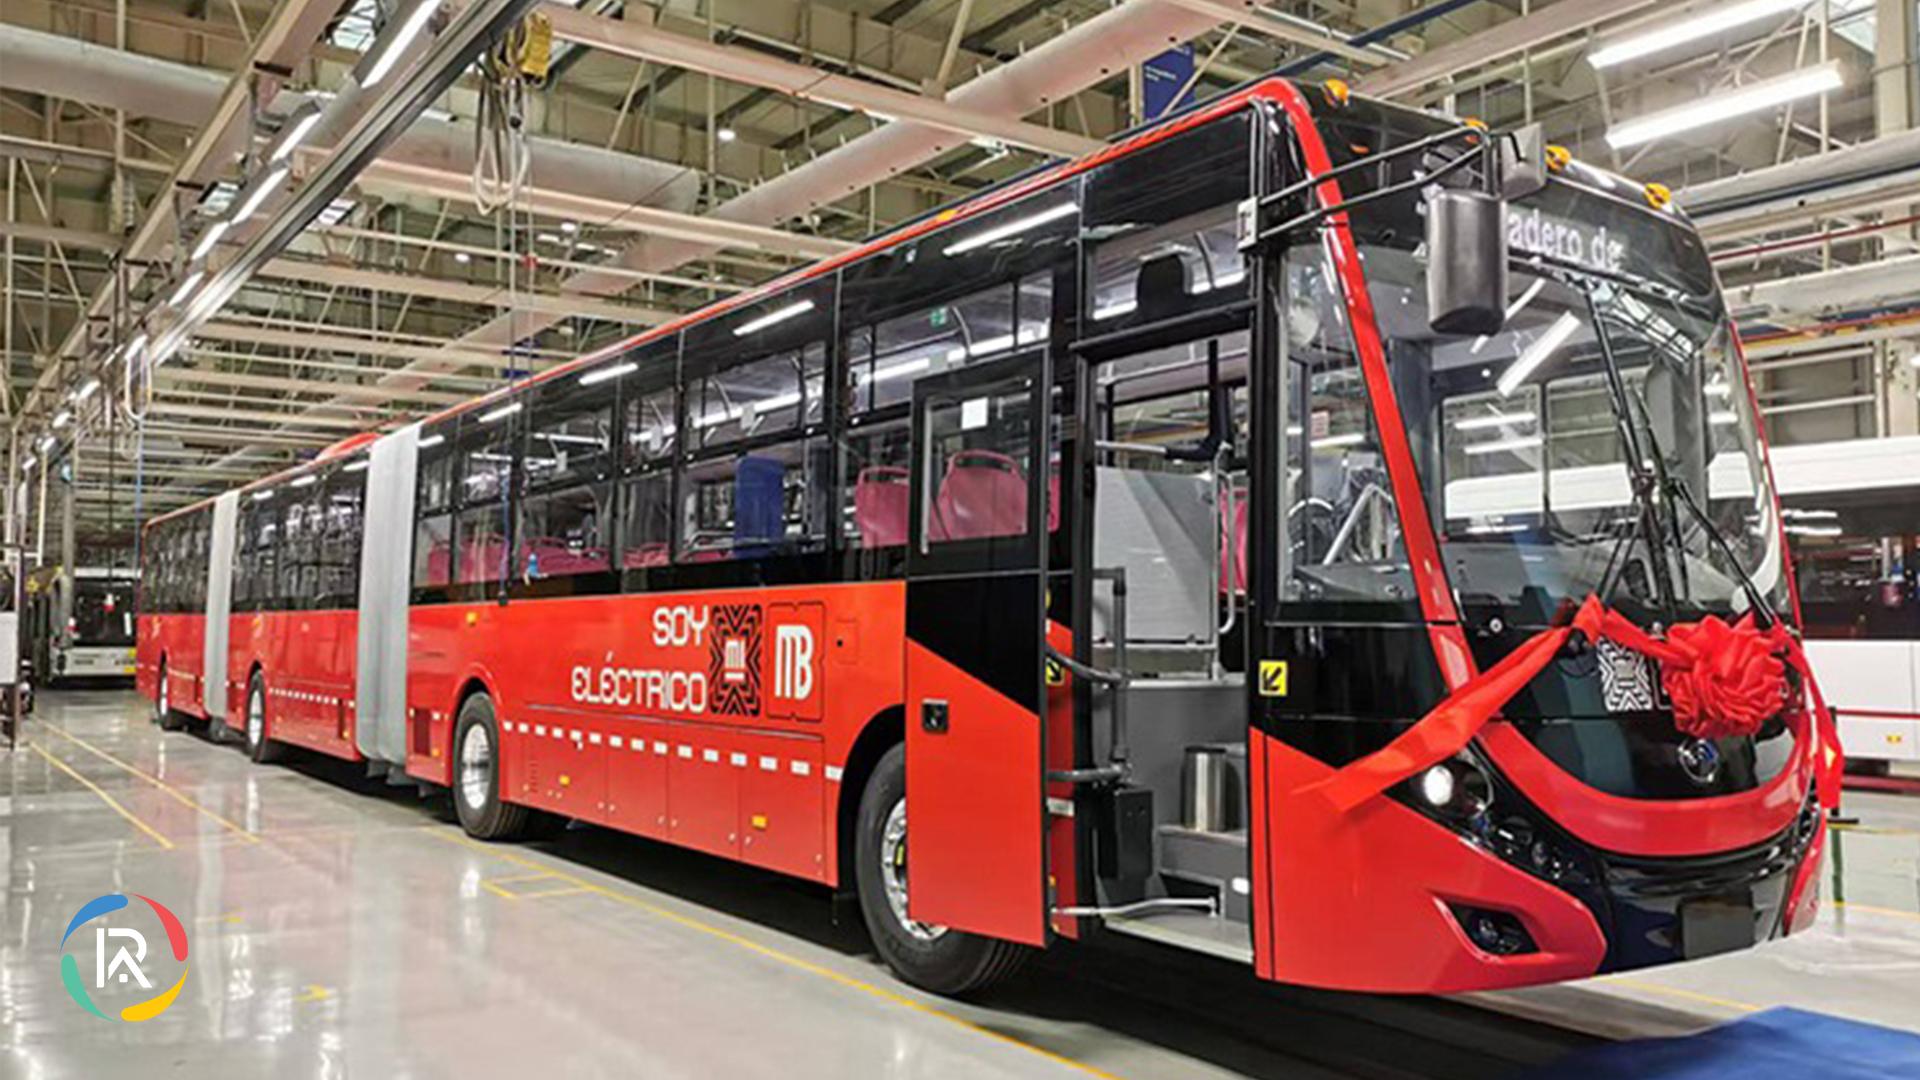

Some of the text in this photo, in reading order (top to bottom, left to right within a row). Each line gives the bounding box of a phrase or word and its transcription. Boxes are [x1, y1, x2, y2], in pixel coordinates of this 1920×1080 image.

[1508, 208, 1581, 261] adero
[652, 605, 709, 646] SOY
[571, 651, 707, 714] ELÉCTRICO
[774, 624, 814, 700] MB
